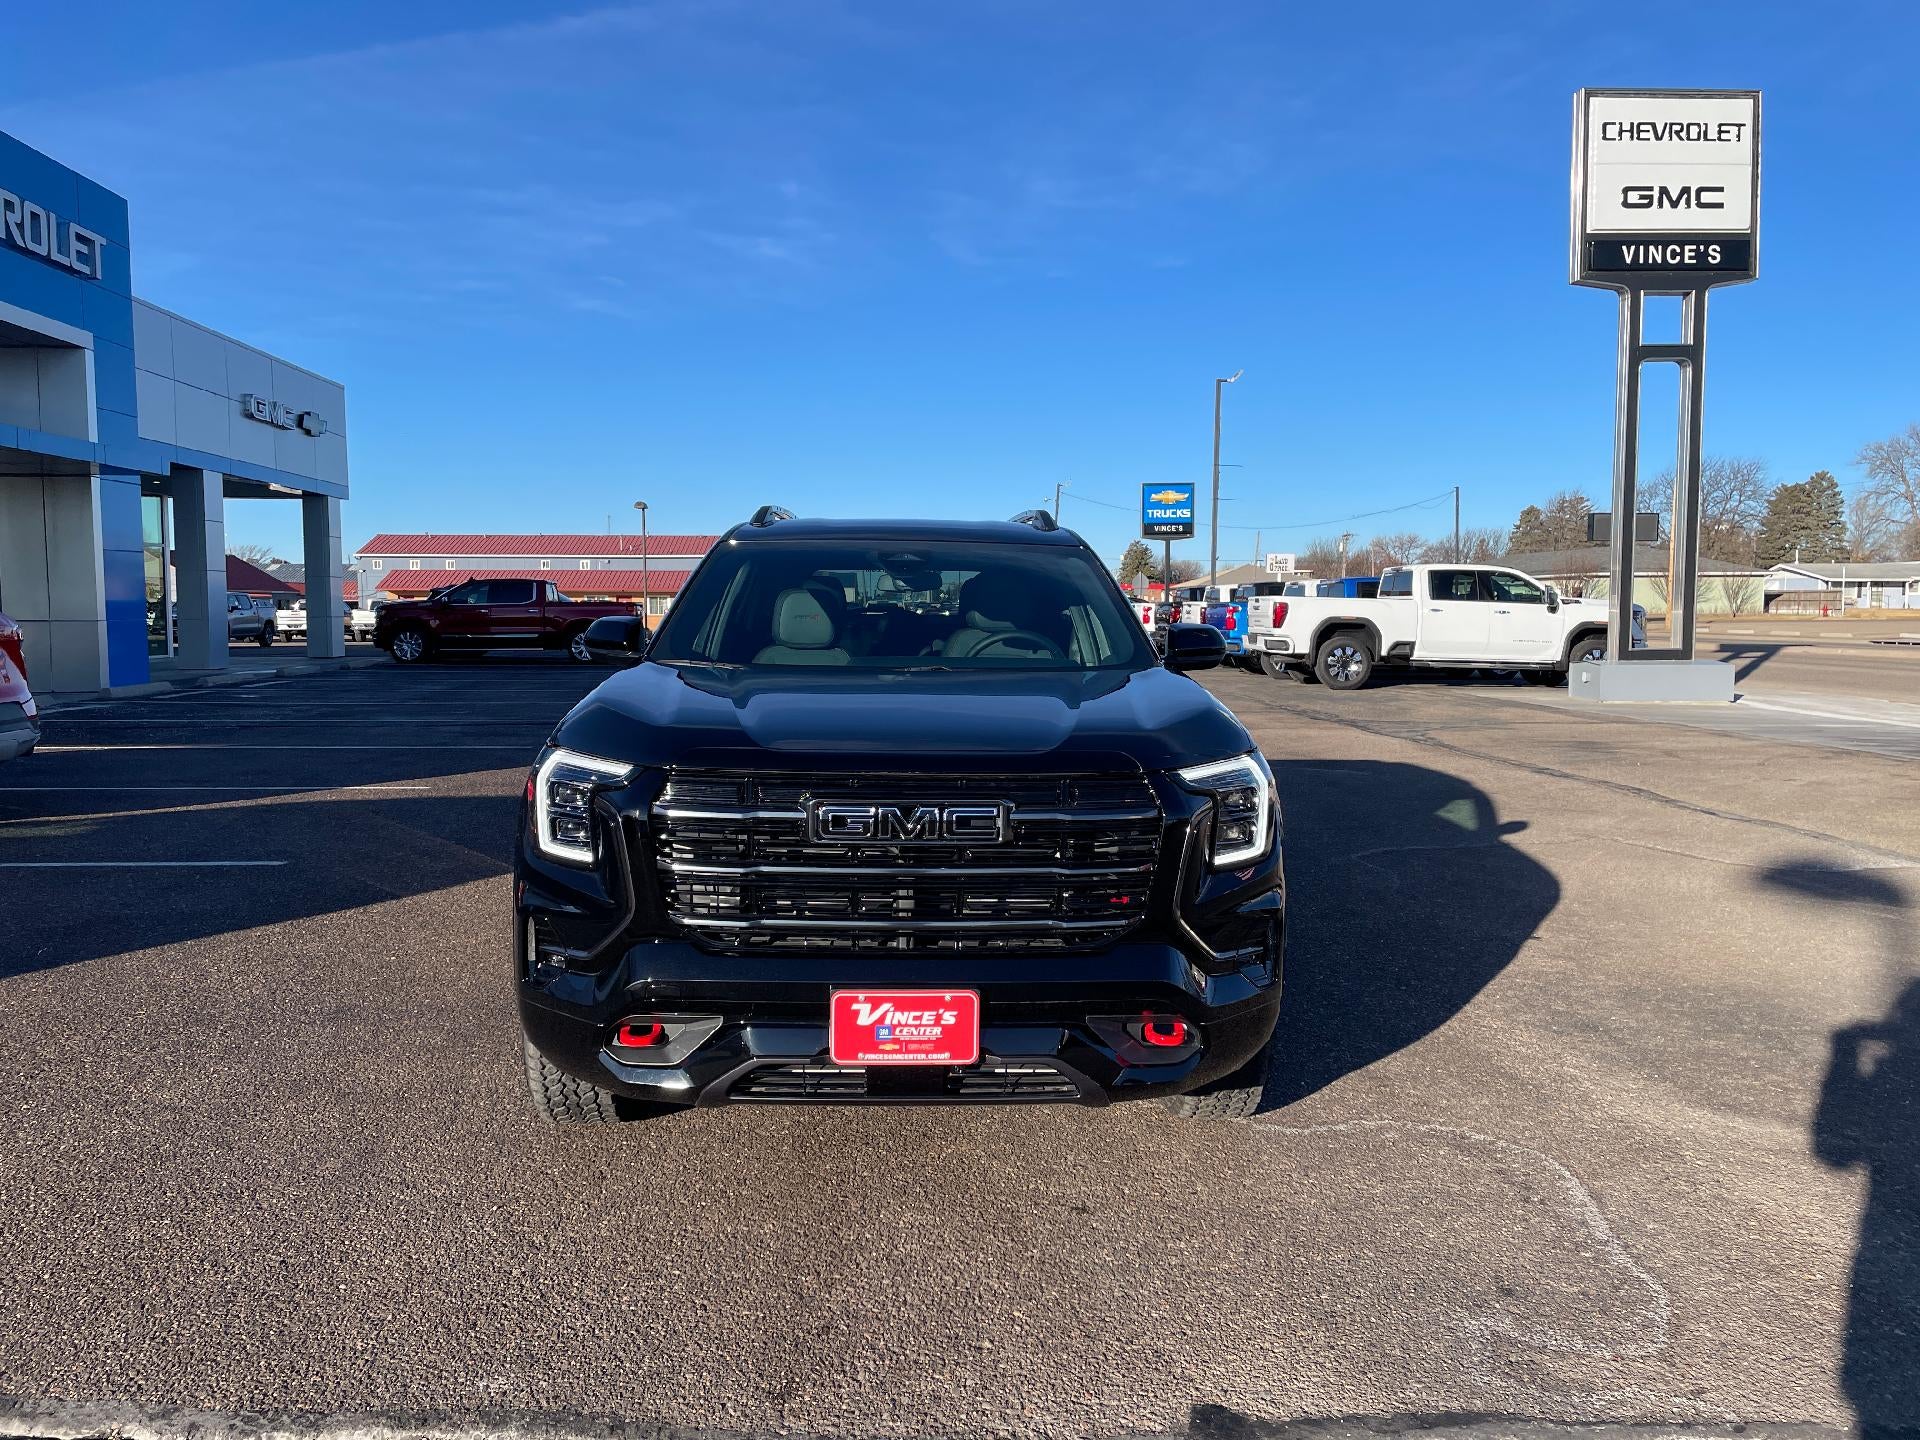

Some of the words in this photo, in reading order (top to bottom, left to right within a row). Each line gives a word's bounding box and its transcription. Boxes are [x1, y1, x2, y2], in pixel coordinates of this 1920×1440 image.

[1602, 121, 1746, 142] CHEVROLET
[1621, 186, 1725, 209] GMC
[1622, 244, 1721, 265] VINCE'S
[249, 393, 296, 431] GMC
[1146, 508, 1191, 518] TRUCKS
[819, 806, 998, 839] GMC
[895, 1026, 942, 1036] CENTER
